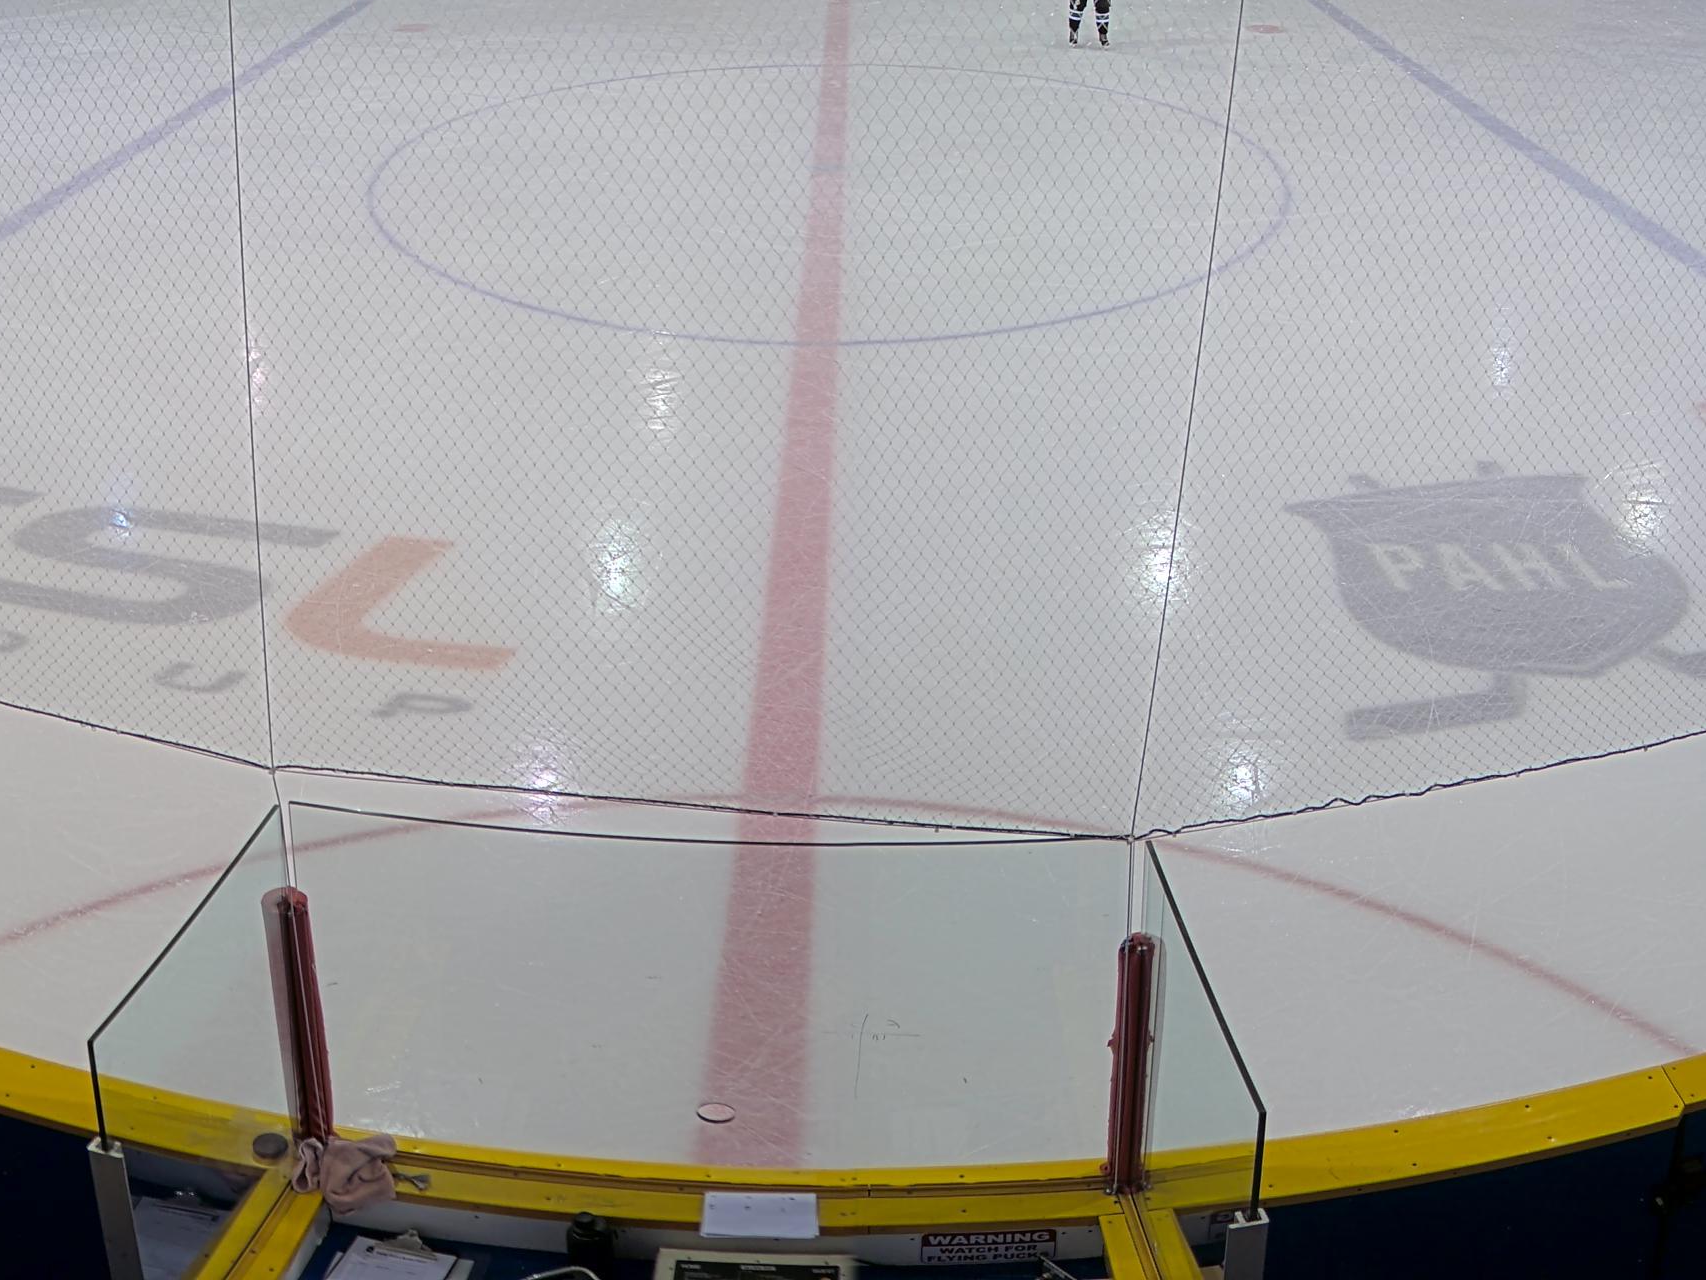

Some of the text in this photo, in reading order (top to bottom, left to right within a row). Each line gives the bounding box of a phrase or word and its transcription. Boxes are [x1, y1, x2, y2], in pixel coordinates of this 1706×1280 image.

[1363, 542, 1633, 592] PAHL
[928, 1231, 1050, 1245] WARNING
[940, 1244, 1037, 1255] WATCH FOR
[927, 1253, 987, 1263] FLYING
